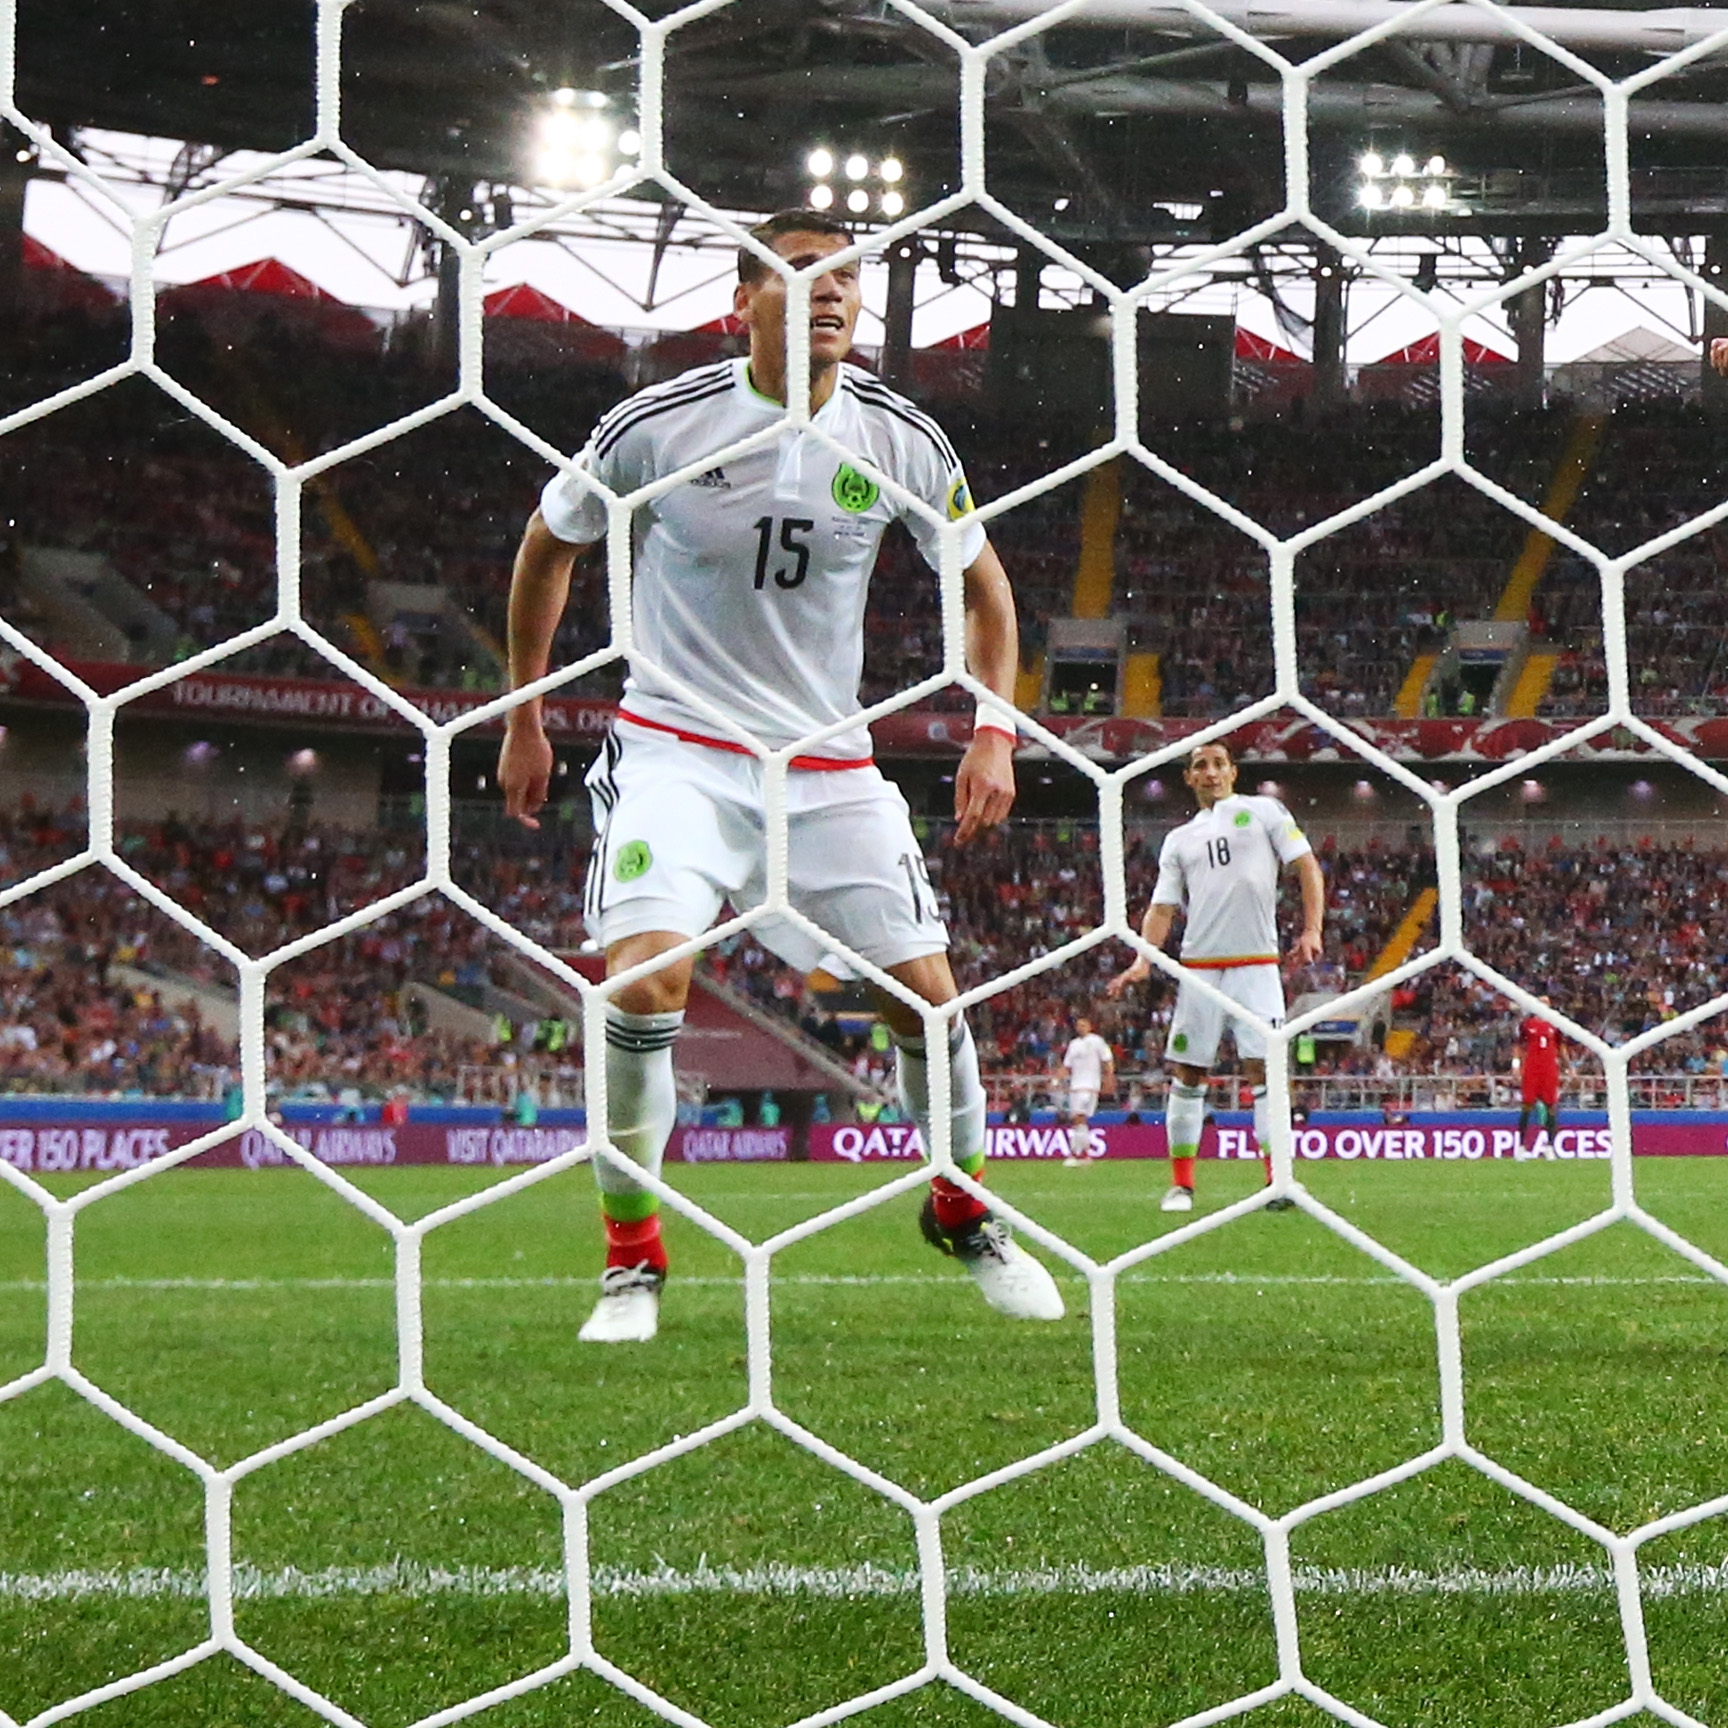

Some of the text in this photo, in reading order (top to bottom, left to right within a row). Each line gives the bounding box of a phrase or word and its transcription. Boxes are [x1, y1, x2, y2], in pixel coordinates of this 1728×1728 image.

[753, 515, 815, 590] 15
[1206, 836, 1231, 869] 18
[0, 1129, 34, 1169] ER
[832, 1127, 1107, 1163] QATA IRWAS
[1217, 1130, 1259, 1159] FL
[1333, 1130, 1424, 1160] OVER
[1433, 1130, 1484, 1160] 150
[1492, 1130, 1614, 1159] PLACES
